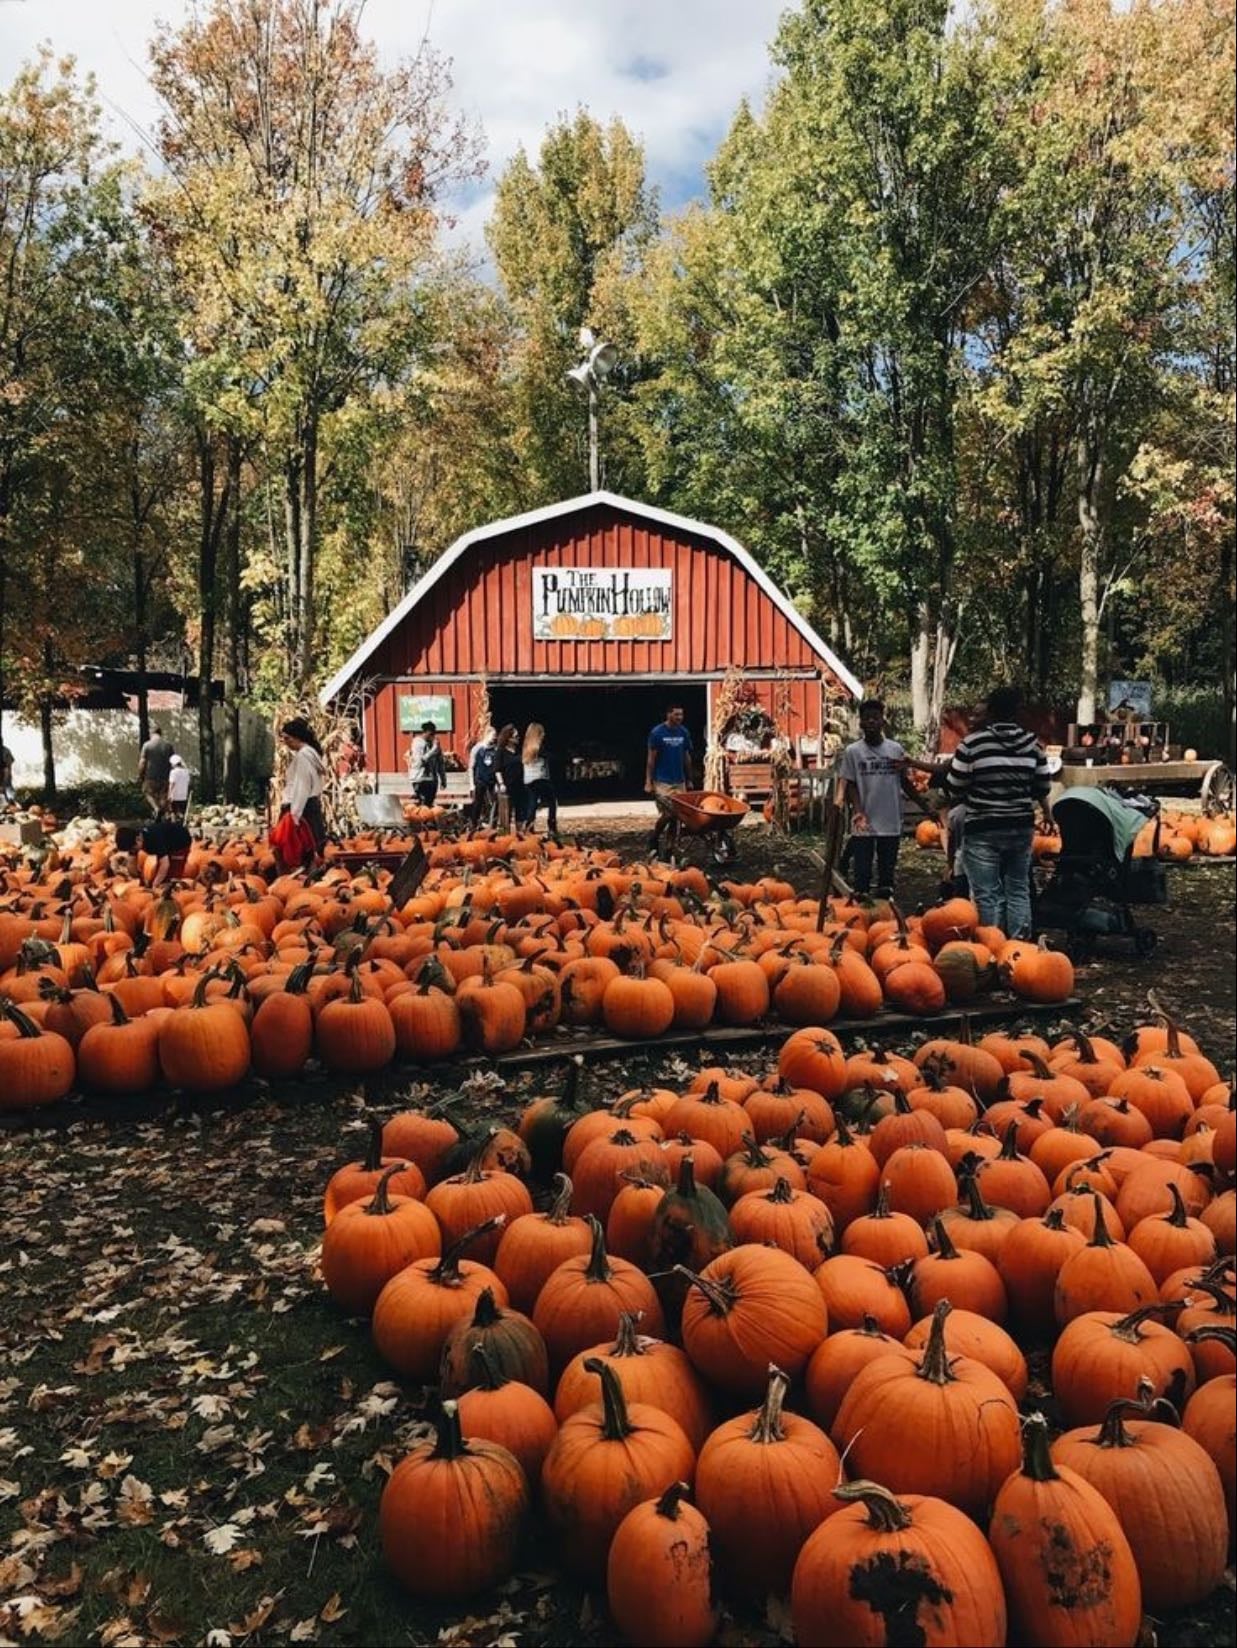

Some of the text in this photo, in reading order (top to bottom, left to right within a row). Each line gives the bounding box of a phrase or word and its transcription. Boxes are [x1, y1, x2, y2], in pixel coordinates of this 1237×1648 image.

[567, 569, 598, 587] THE
[541, 572, 671, 616] PUMPKIN HOLLOW
